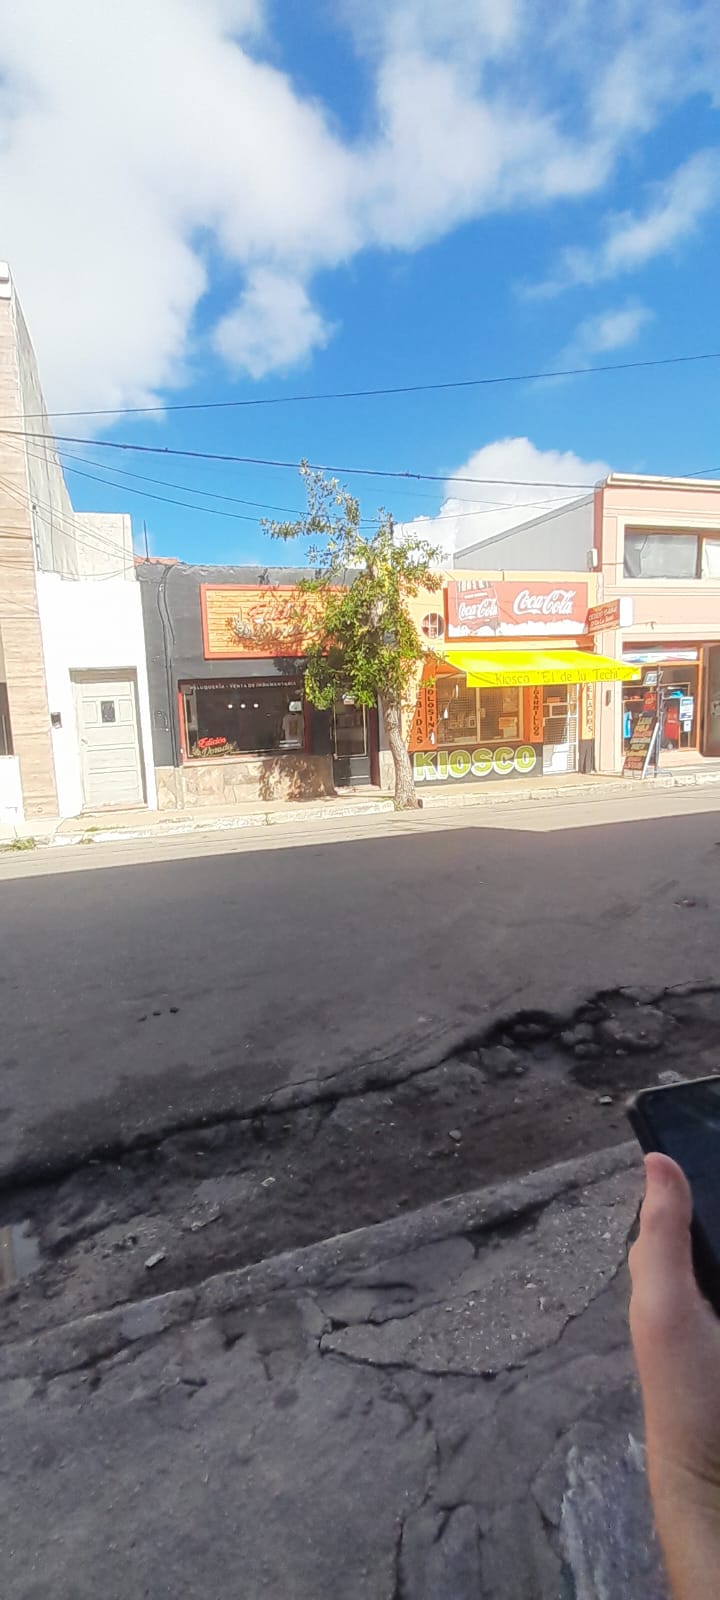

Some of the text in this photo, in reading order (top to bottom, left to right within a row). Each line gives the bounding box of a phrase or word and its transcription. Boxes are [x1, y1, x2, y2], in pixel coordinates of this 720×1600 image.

[513, 589, 577, 615] Coca-Cola
[494, 672, 530, 685] Kiosco
[560, 672, 573, 682] de
[427, 684, 436, 744] OLOSIN
[586, 685, 594, 733] ELADOS
[413, 745, 537, 782] KIOSCO
